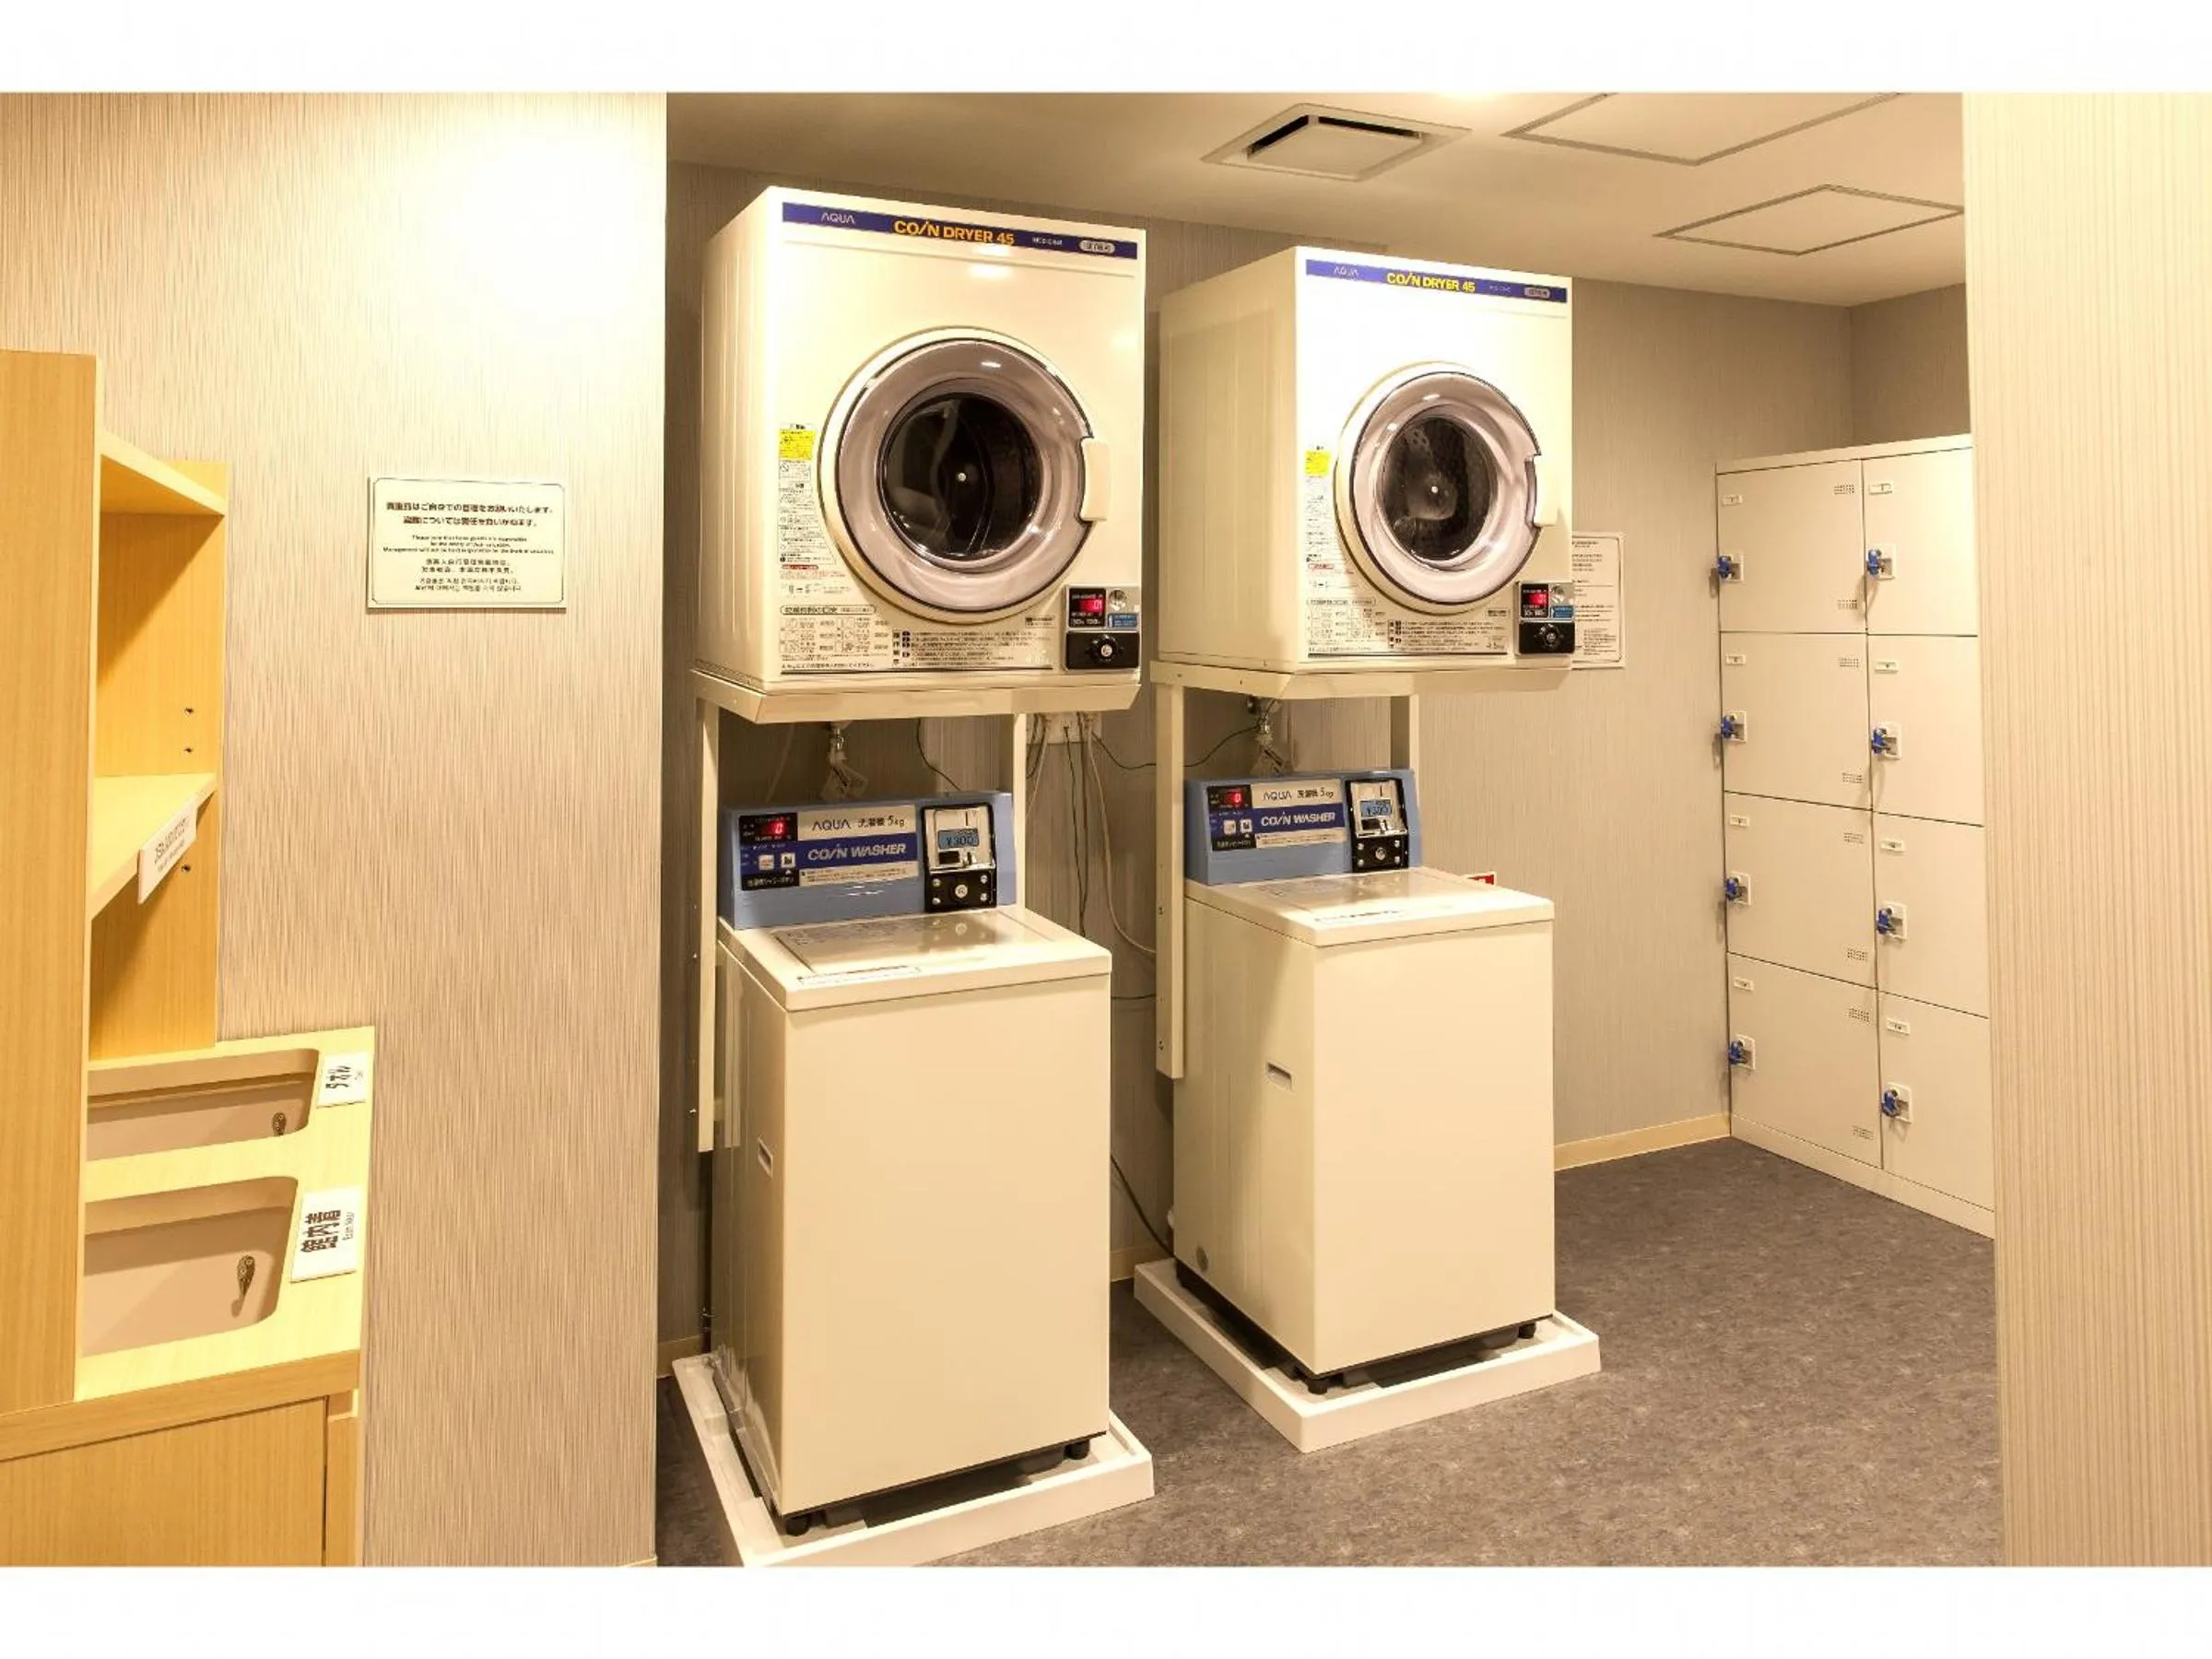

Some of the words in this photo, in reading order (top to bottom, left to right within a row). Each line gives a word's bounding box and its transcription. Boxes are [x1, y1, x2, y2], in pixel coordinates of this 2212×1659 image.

[821, 212, 855, 225] AQUA
[943, 226, 993, 243] DRYER
[996, 232, 1015, 245] 45
[1423, 276, 1459, 291] DRYER
[1463, 282, 1476, 292] 45
[1263, 788, 1292, 801] AQUA
[812, 818, 852, 831] AQUA
[1293, 812, 1335, 824] WASHER
[851, 842, 907, 859] WASHER
[300, 1209, 341, 1253] 館内着
